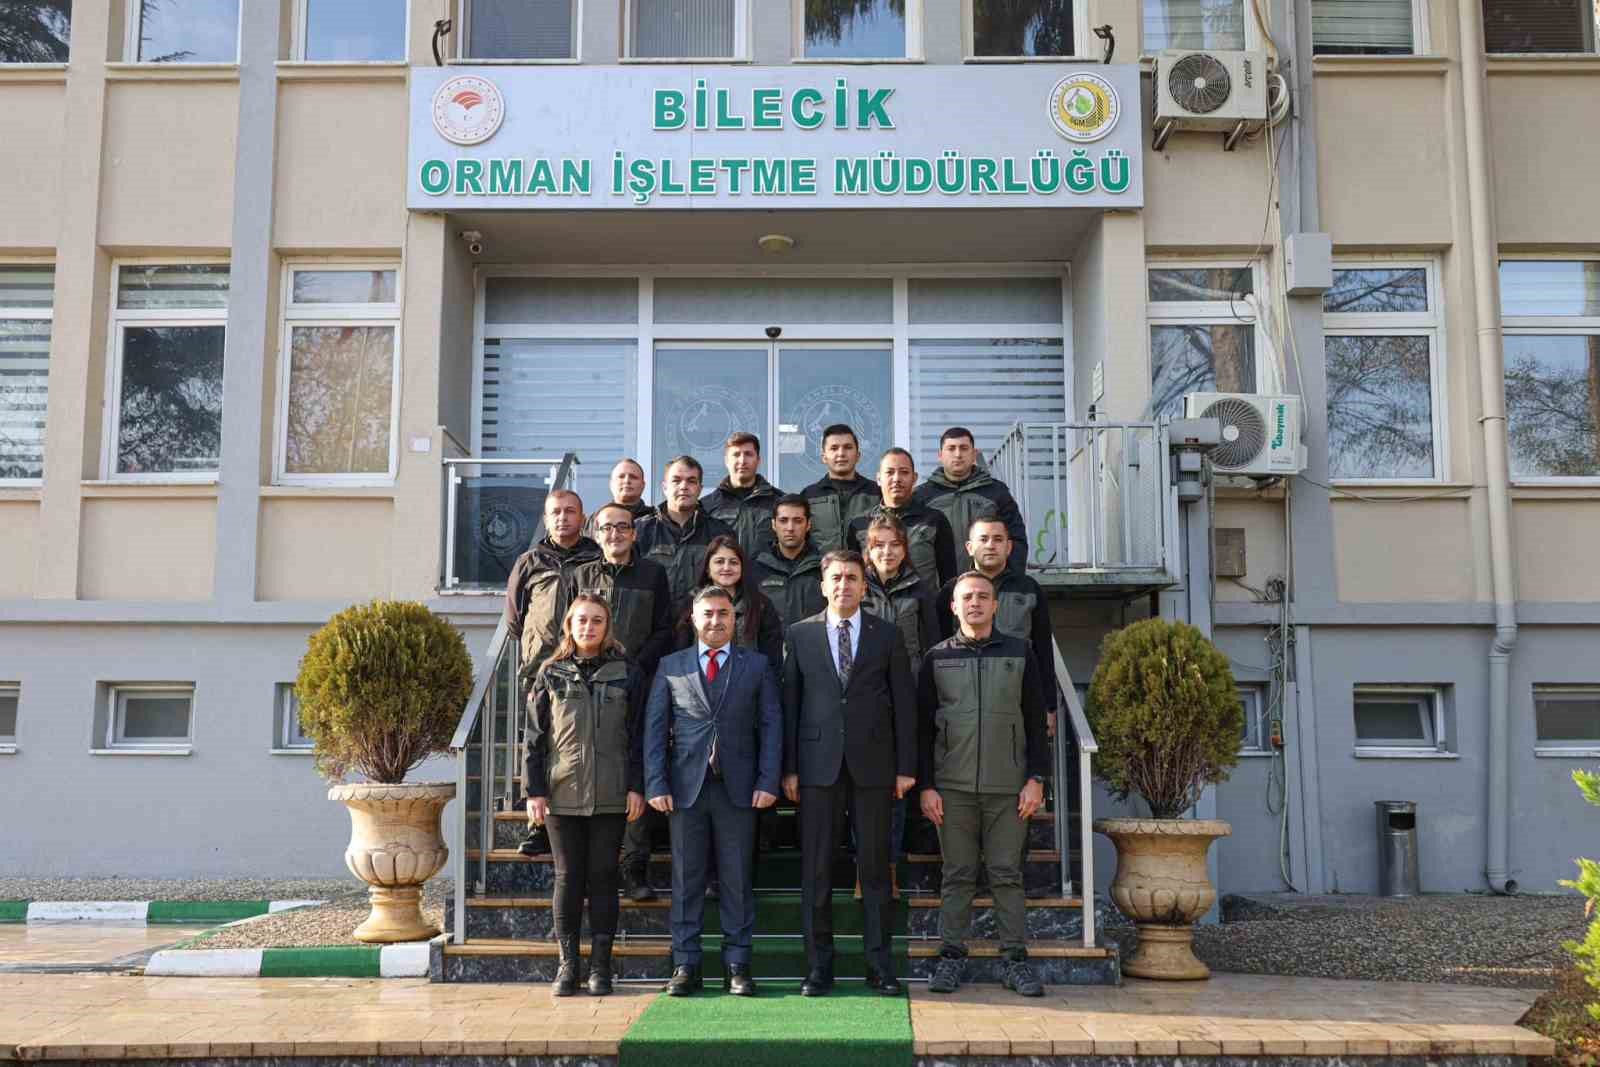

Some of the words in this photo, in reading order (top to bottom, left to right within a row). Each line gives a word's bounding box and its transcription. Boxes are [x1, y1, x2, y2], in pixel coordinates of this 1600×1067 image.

[653, 78, 894, 130] BİLECİK
[420, 158, 592, 194] ORMAN
[612, 151, 817, 204] İŞLETME
[834, 149, 1131, 194] MÜDÜRLÜĞÜ
